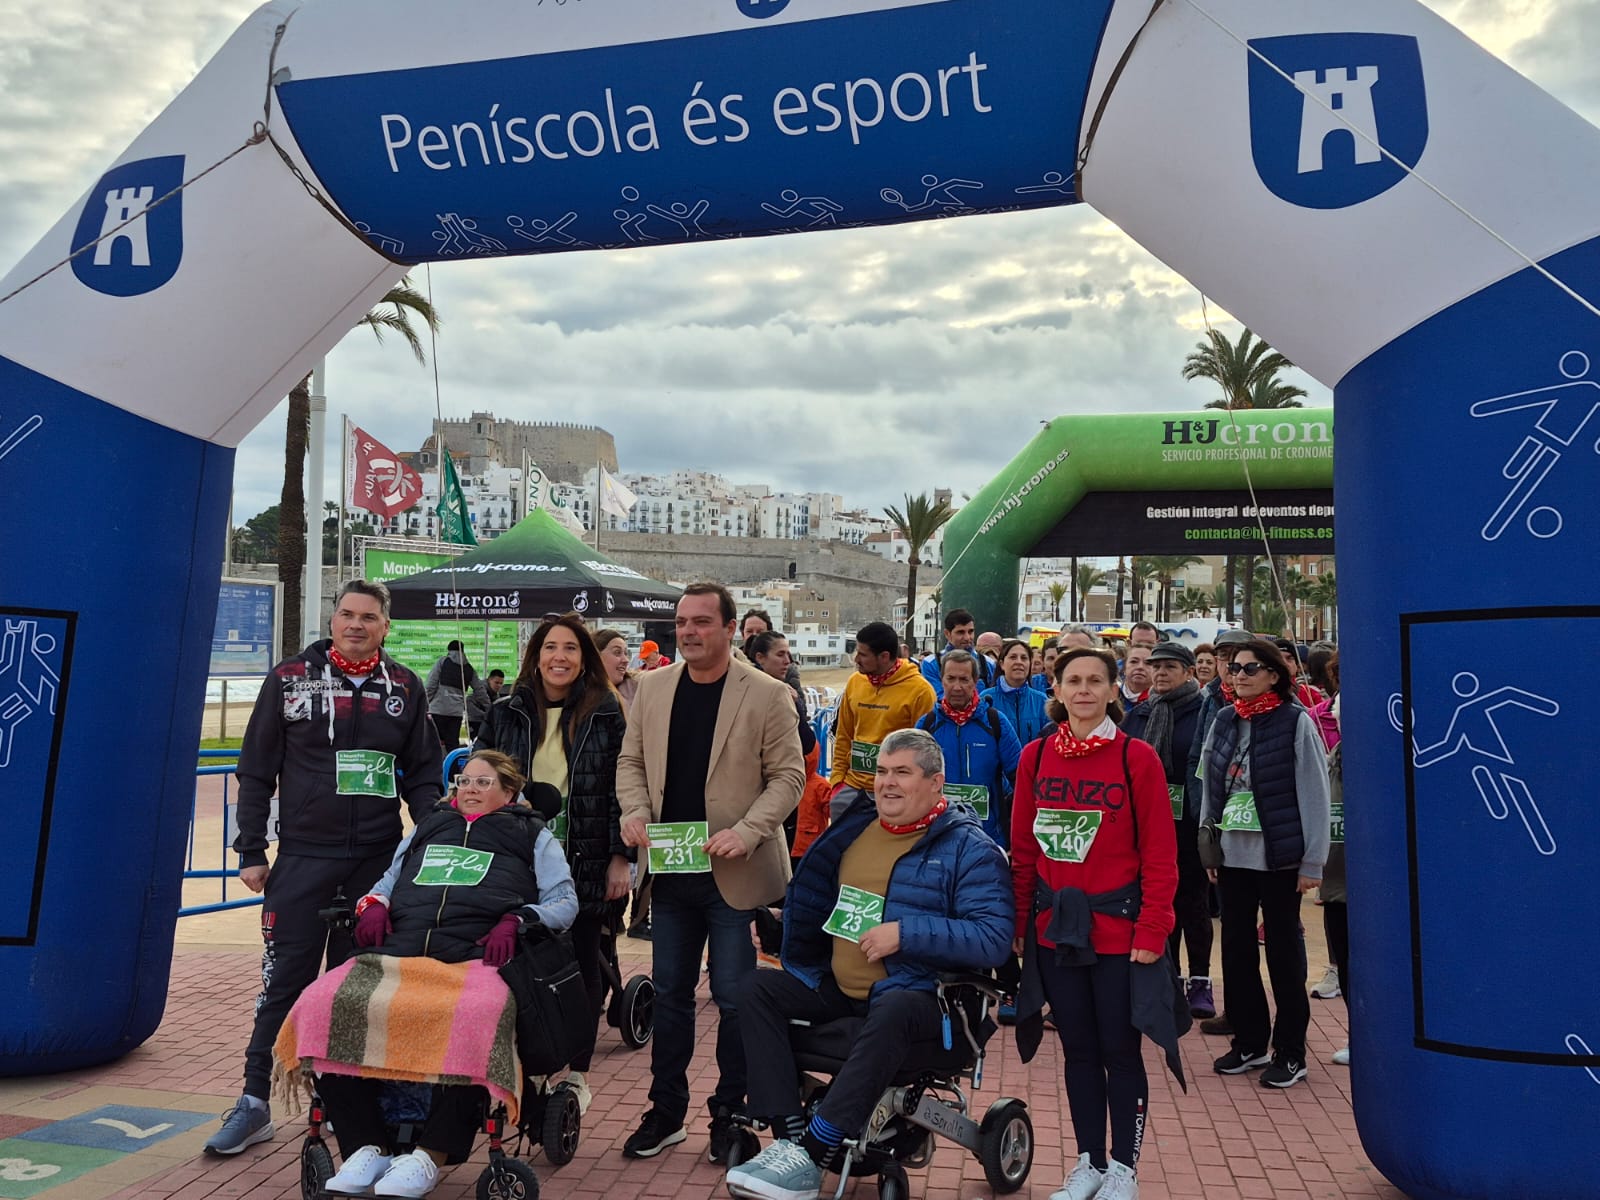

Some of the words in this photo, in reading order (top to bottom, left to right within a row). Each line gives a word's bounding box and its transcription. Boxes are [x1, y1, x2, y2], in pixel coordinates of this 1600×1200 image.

[379, 87, 659, 173] Peníscola
[682, 82, 751, 146] és
[772, 51, 993, 146] esport
[1161, 419, 1333, 445] H&Jcron
[1161, 449, 1203, 462] SERVICIO
[1270, 447, 1283, 460] DE
[1286, 445, 1333, 459] CRONOME
[980, 448, 1070, 535] www.hj-crono.es
[1146, 505, 1191, 519] Gestión
[1192, 505, 1238, 519] integral
[1242, 505, 1257, 518] de
[1259, 505, 1307, 517] eventos
[431, 562, 568, 574] www.hj-crono.es
[363, 772, 375, 788] 4
[1034, 776, 1125, 811] KENZO
[675, 826, 705, 847] ela
[1048, 834, 1085, 854] 140
[450, 853, 487, 872] ela
[663, 846, 694, 865] 231
[444, 866, 455, 879] 1
[841, 912, 863, 933] 23
[1133, 1112, 1144, 1153] TOMMY
